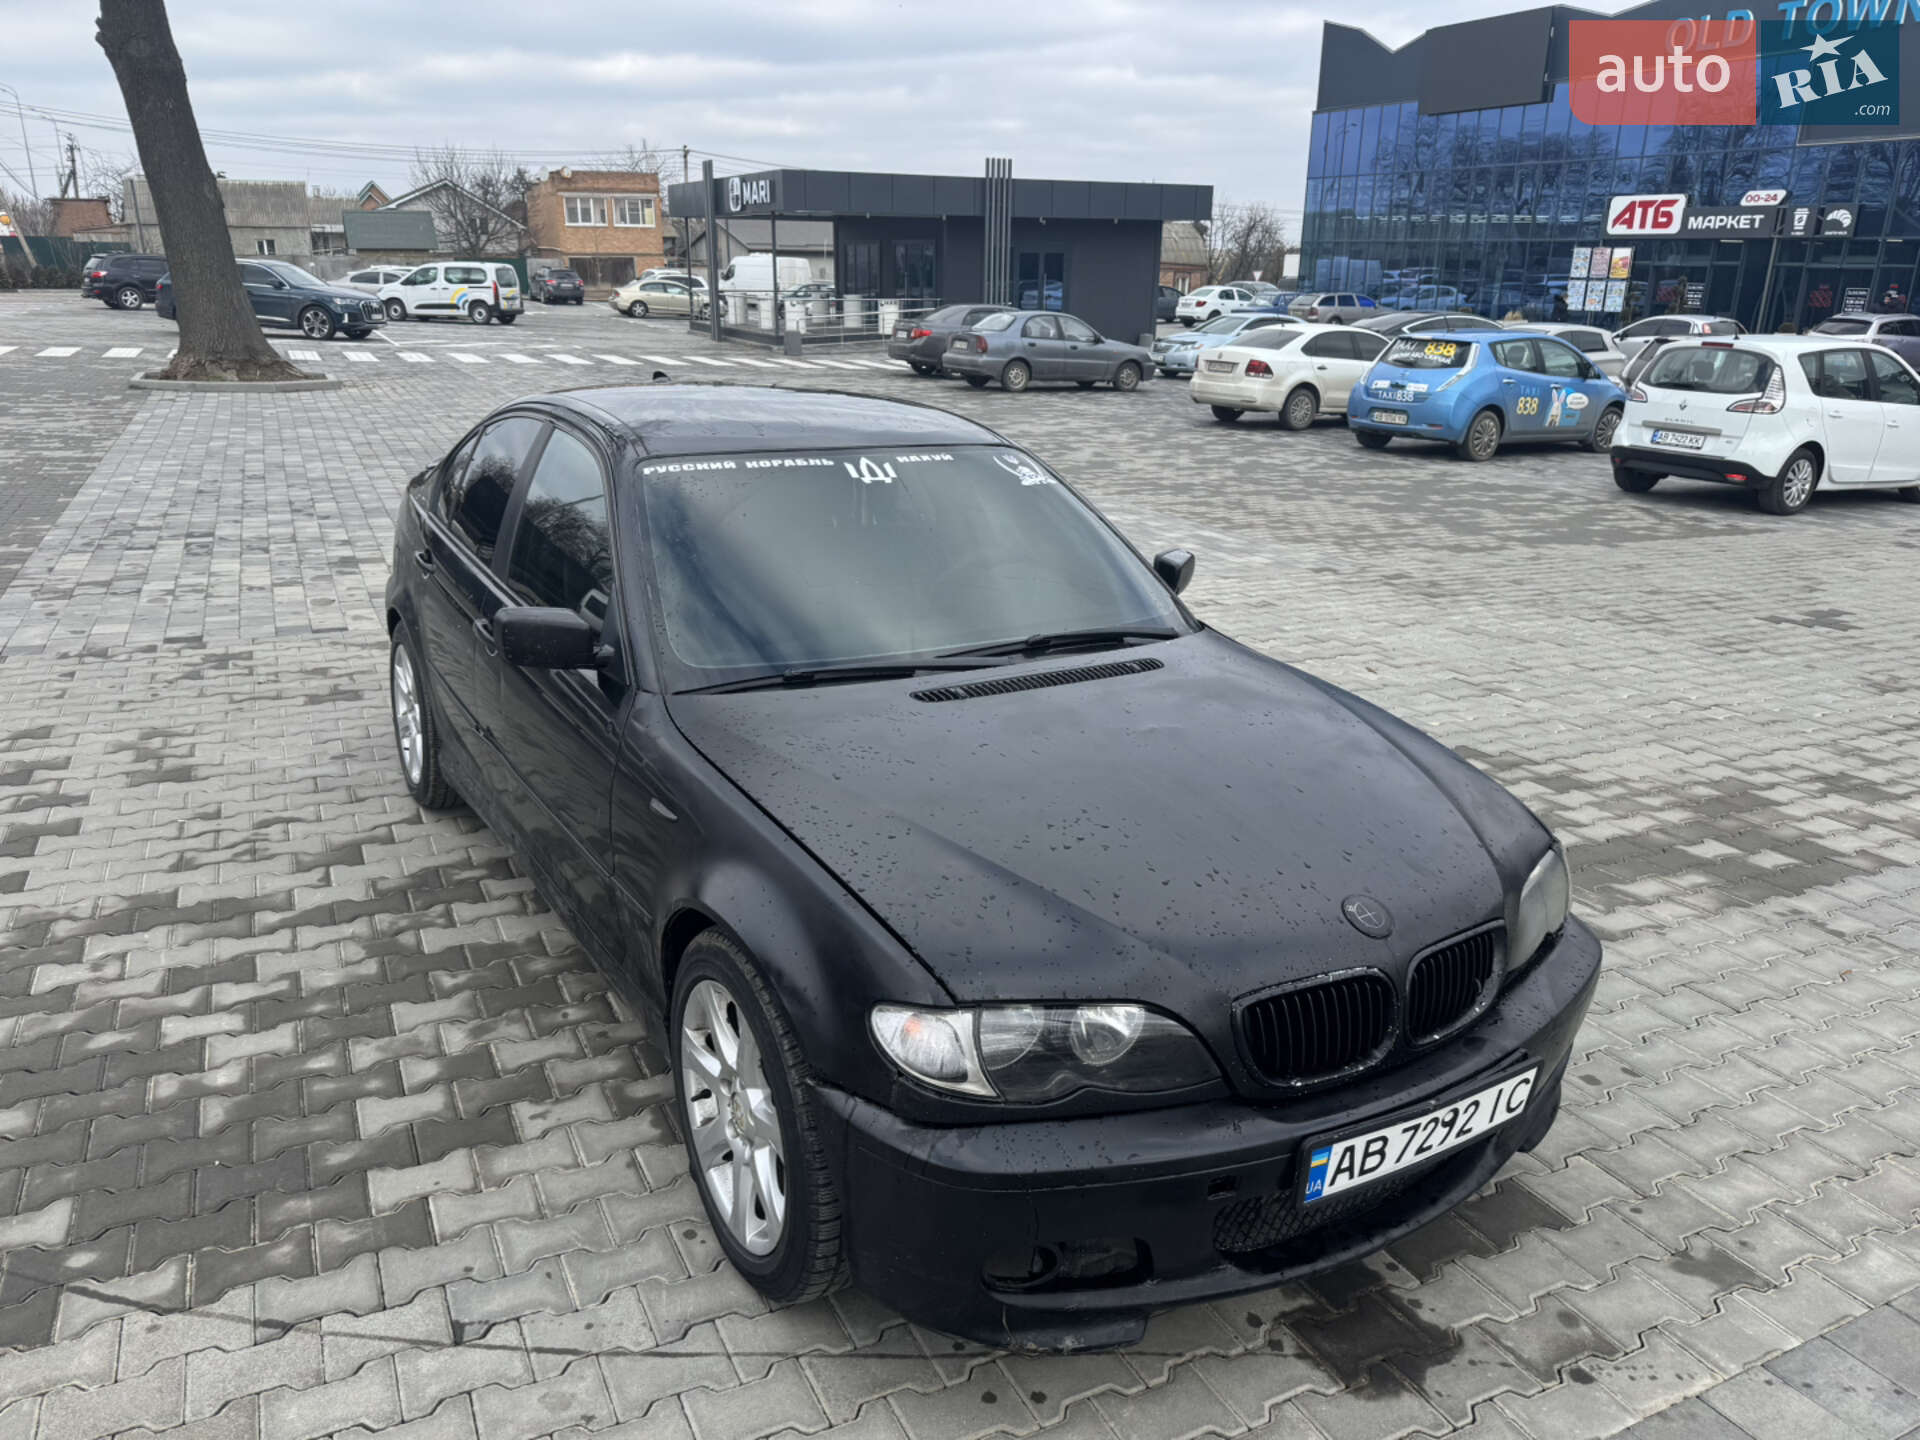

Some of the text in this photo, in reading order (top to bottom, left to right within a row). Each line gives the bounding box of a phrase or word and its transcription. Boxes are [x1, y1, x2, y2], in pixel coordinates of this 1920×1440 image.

[1665, 9, 1754, 52] OLD
[742, 179, 770, 205] MARI
[1745, 193, 1779, 204] 00-24
[1611, 199, 1765, 230] АТБ МАРКЕТ
[1424, 342, 1457, 358] 838
[1516, 396, 1539, 415] 838
[643, 460, 737, 475] РУССКИЙ
[745, 457, 835, 469] КОРАБЛЬ
[1329, 1077, 1531, 1186] AB 7292 IC
[1305, 1180, 1323, 1195] UA
